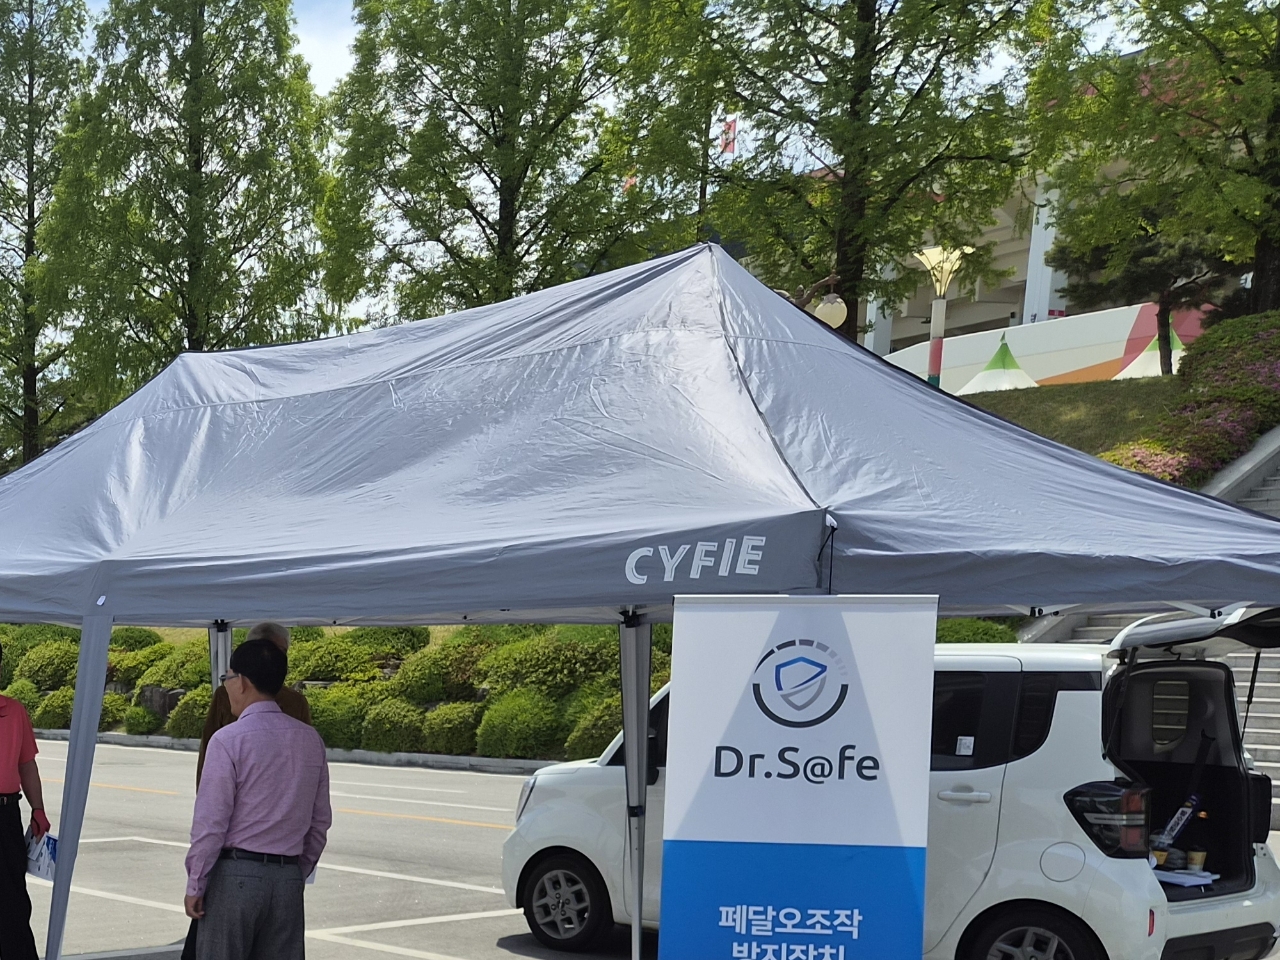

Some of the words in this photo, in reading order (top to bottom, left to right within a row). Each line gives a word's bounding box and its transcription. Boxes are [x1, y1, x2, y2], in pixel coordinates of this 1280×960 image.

[625, 535, 766, 585] CYFIE
[714, 744, 880, 784] Dr.S@fe
[719, 905, 863, 939] 페달오조작
